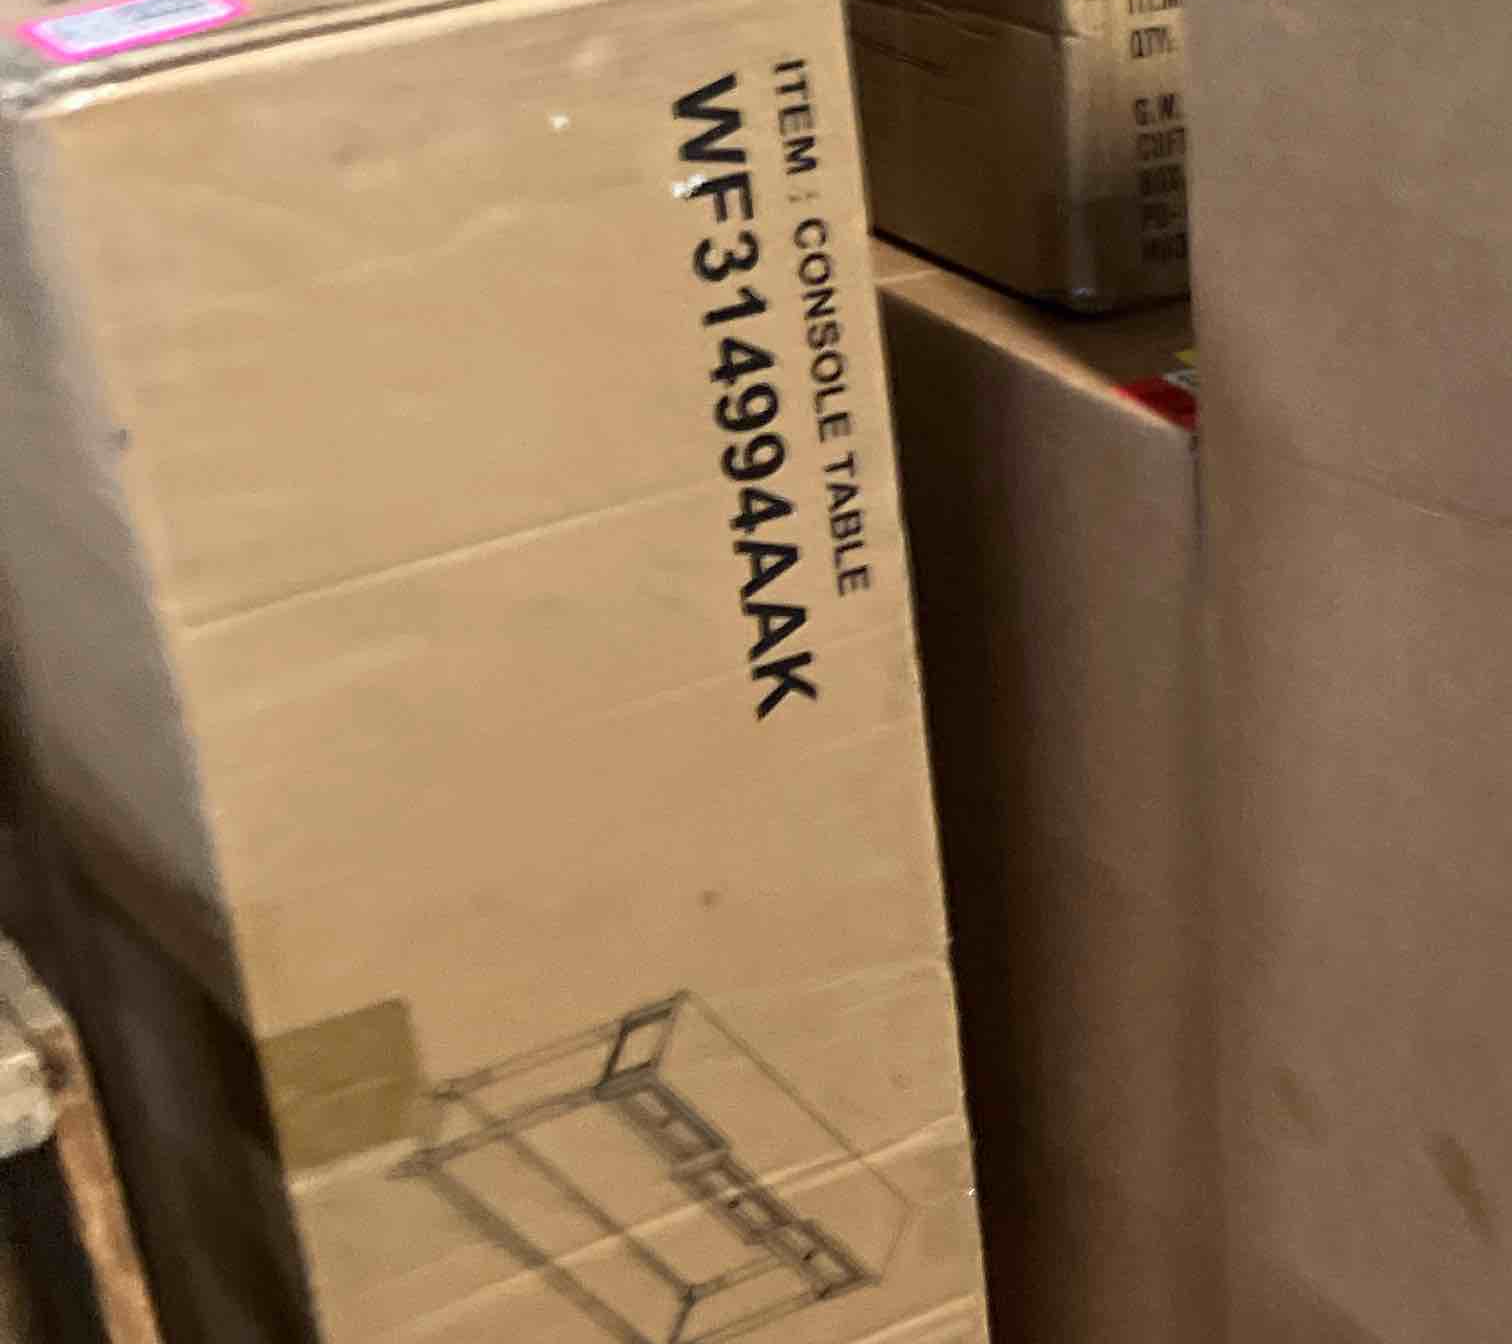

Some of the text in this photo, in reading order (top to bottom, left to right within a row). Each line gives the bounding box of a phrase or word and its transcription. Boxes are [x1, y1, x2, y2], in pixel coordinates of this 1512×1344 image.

[771, 56, 818, 175] ITEM
[671, 71, 820, 722] WF314994AAK
[793, 216, 852, 444] CONSOLE
[821, 450, 872, 598] TABLE
